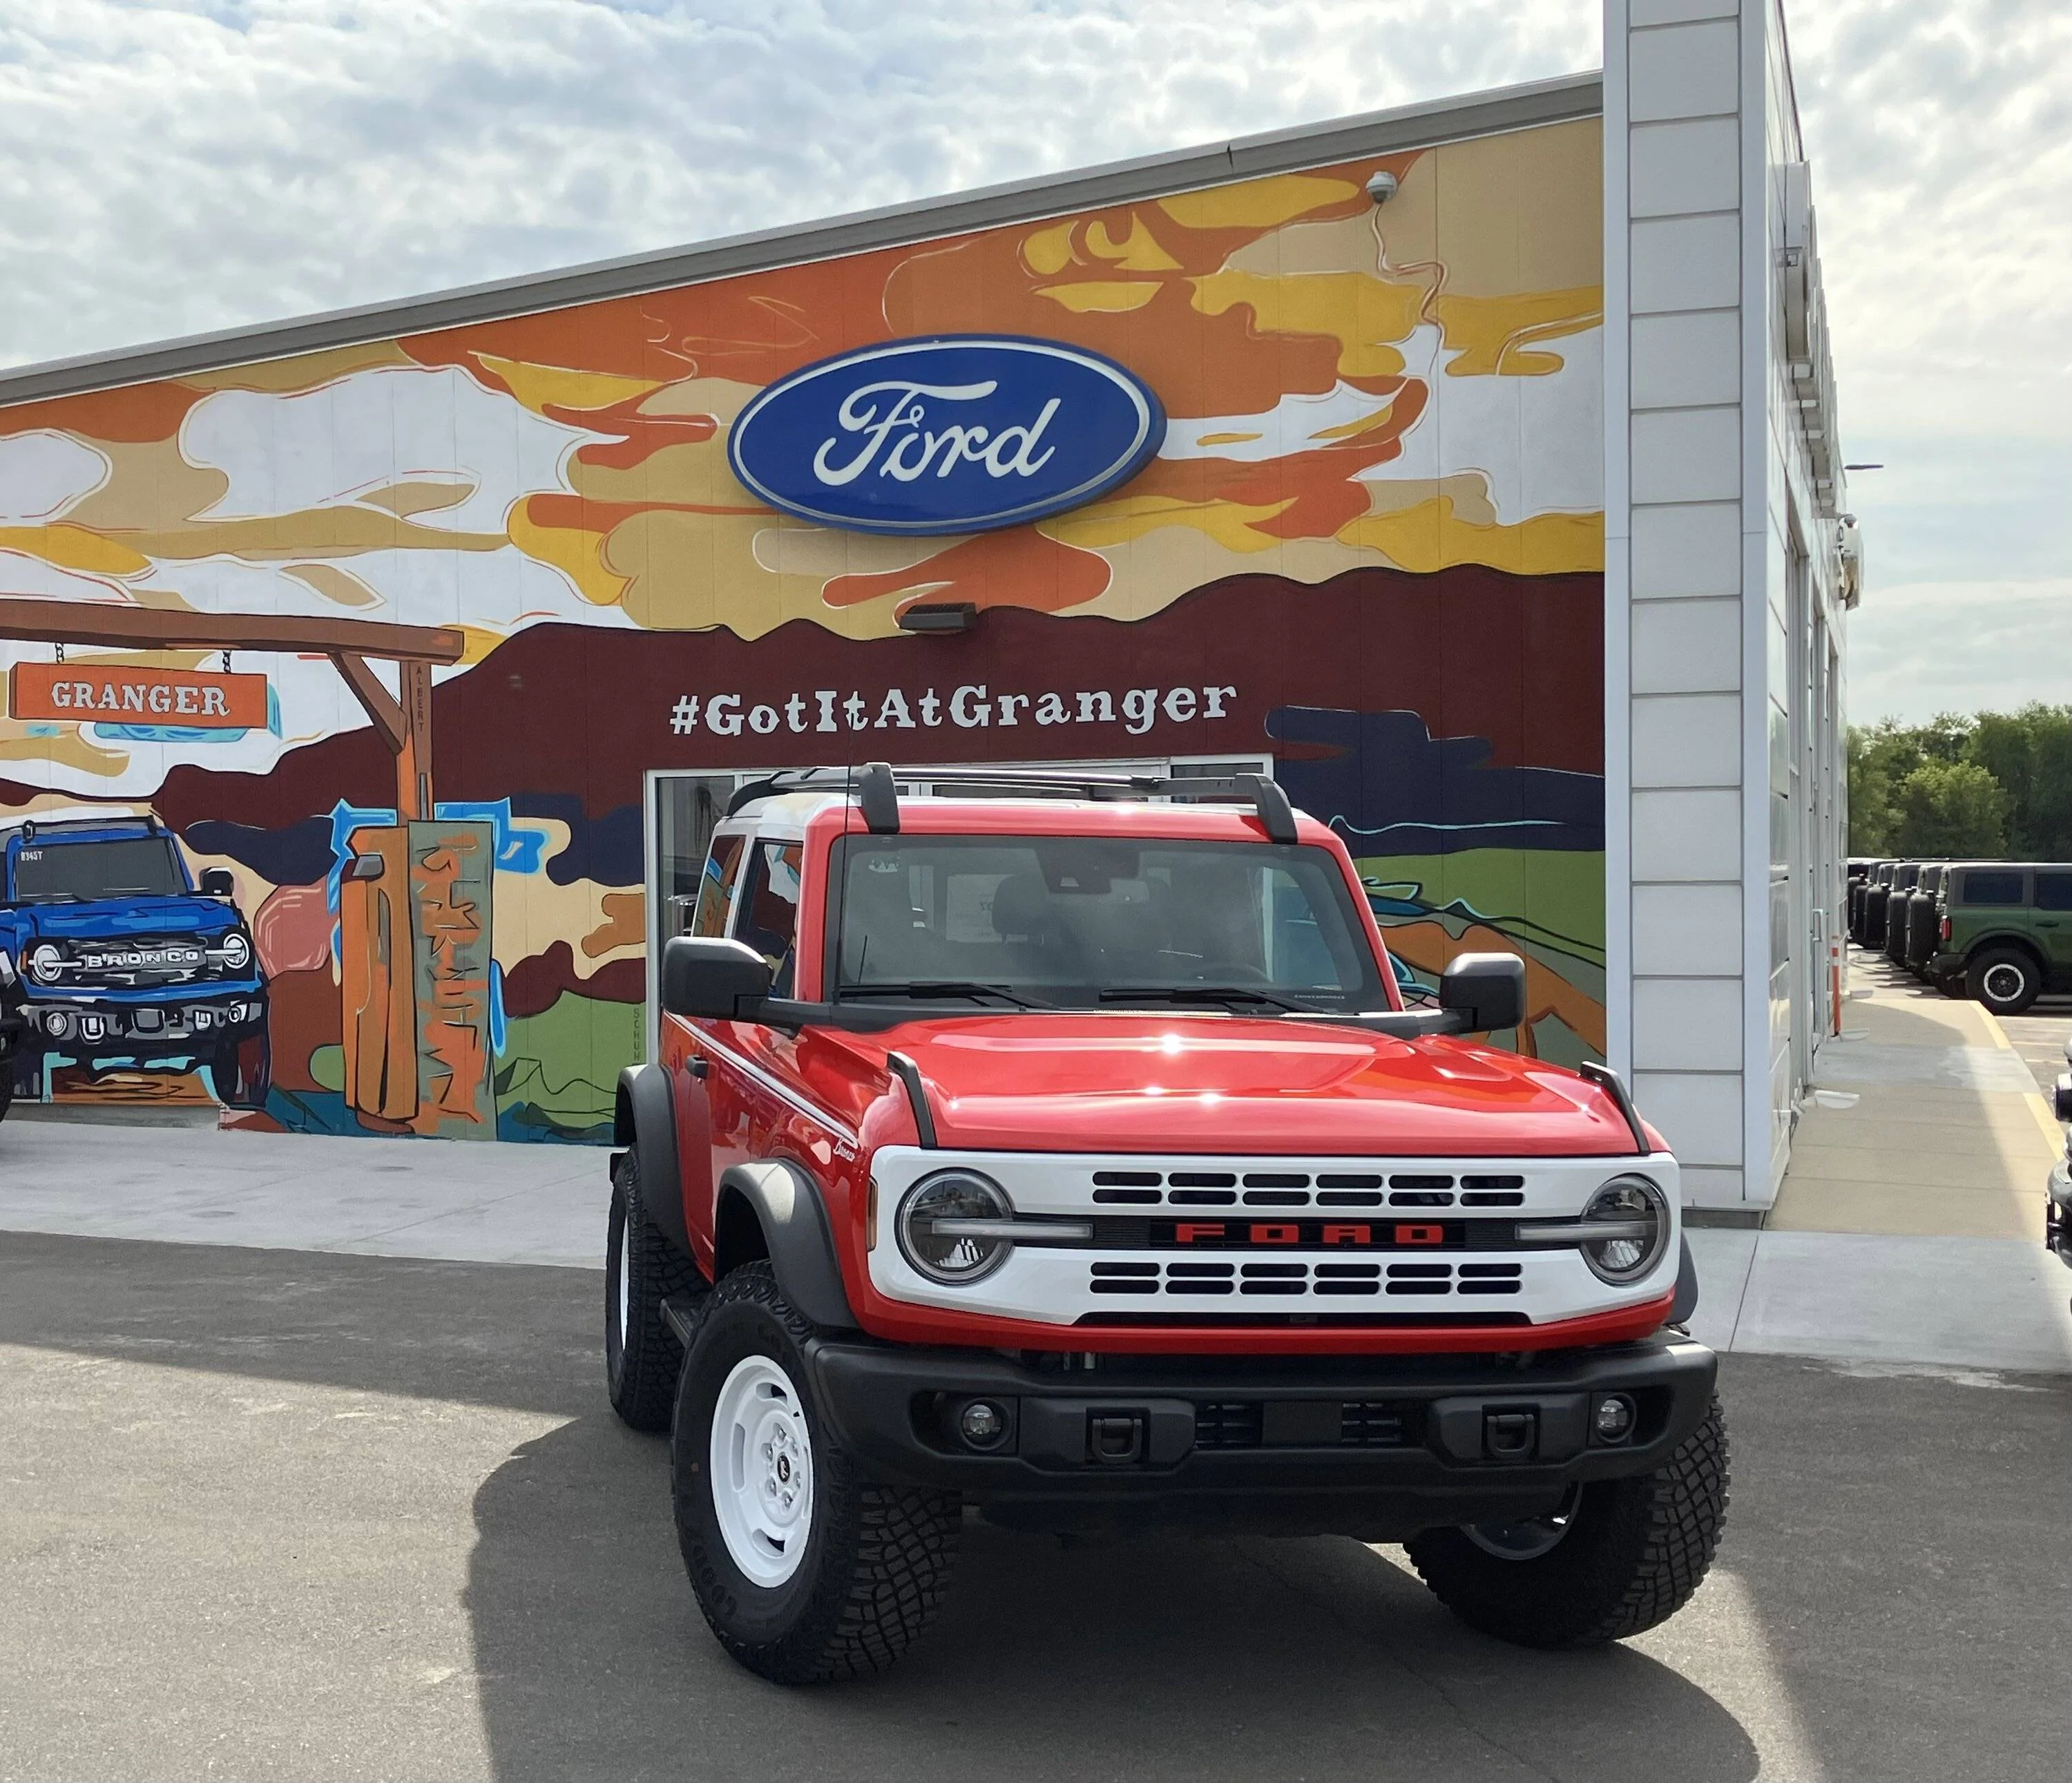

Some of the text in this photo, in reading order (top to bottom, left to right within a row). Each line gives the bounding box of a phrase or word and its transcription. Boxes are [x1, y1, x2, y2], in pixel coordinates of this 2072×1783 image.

[813, 380, 1061, 486] Ford
[50, 681, 231, 716] GRANGER
[416, 666, 424, 732] ALBERT
[670, 684, 1238, 735] #GotItAtGranger
[88, 950, 199, 968] BRONCO
[1176, 1223, 1443, 1243] FORD
